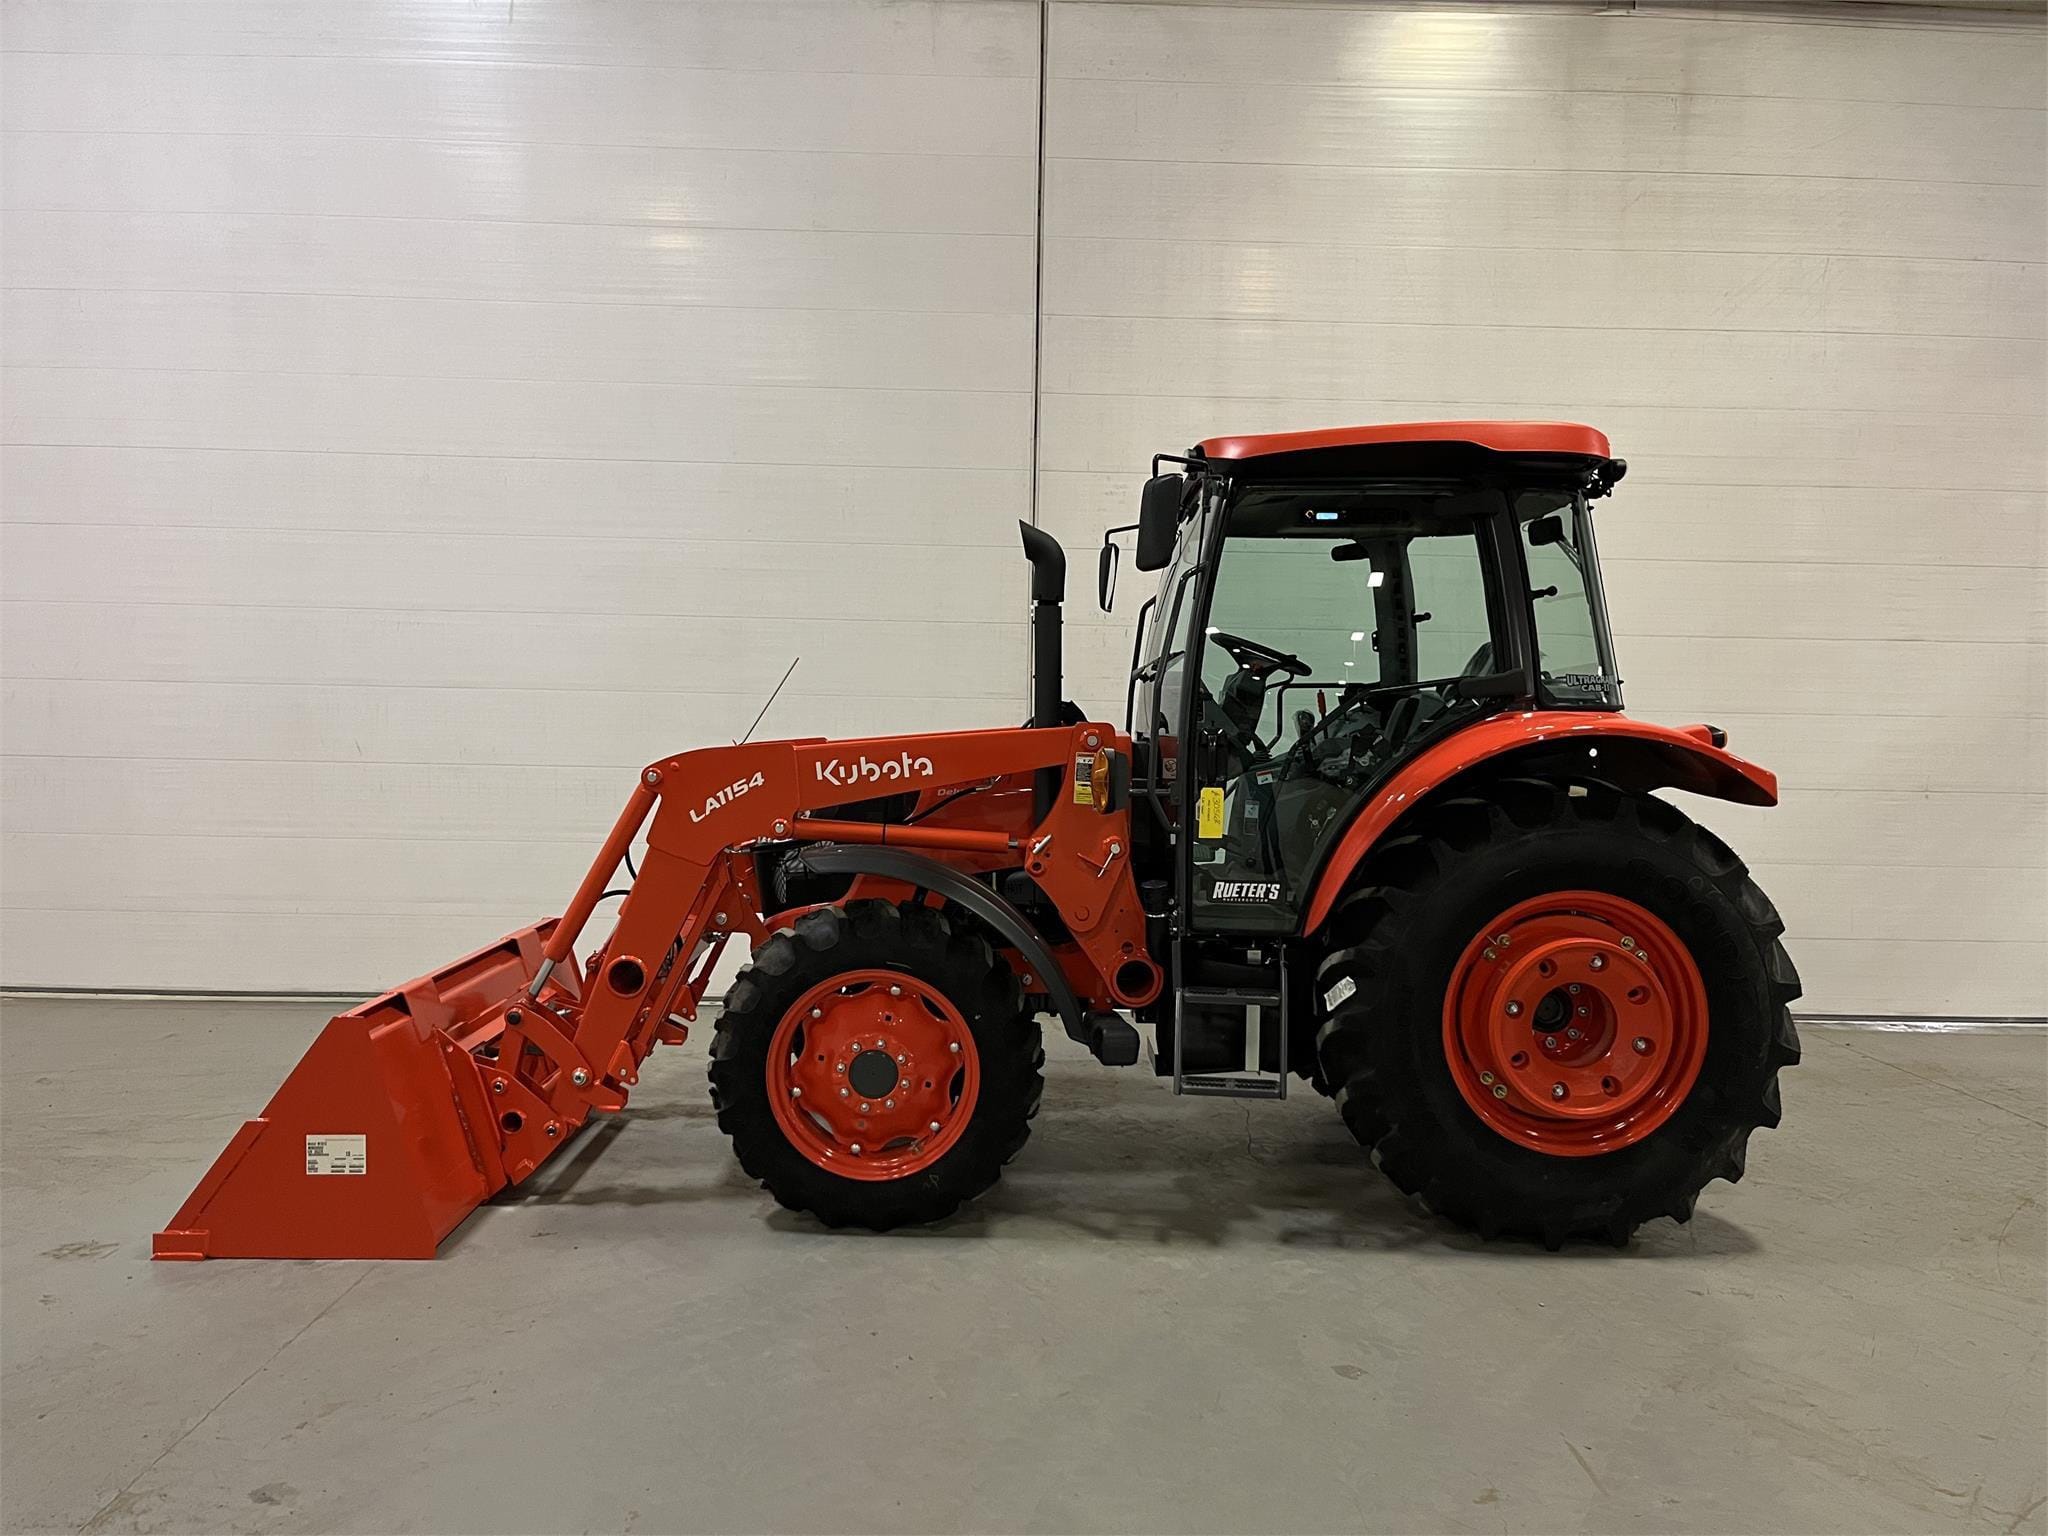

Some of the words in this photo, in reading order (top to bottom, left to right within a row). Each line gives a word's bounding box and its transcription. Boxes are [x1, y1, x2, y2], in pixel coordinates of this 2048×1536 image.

[815, 751, 934, 786] Kubota
[688, 771, 765, 824] LA1154
[1212, 881, 1281, 900] RUETER'S
